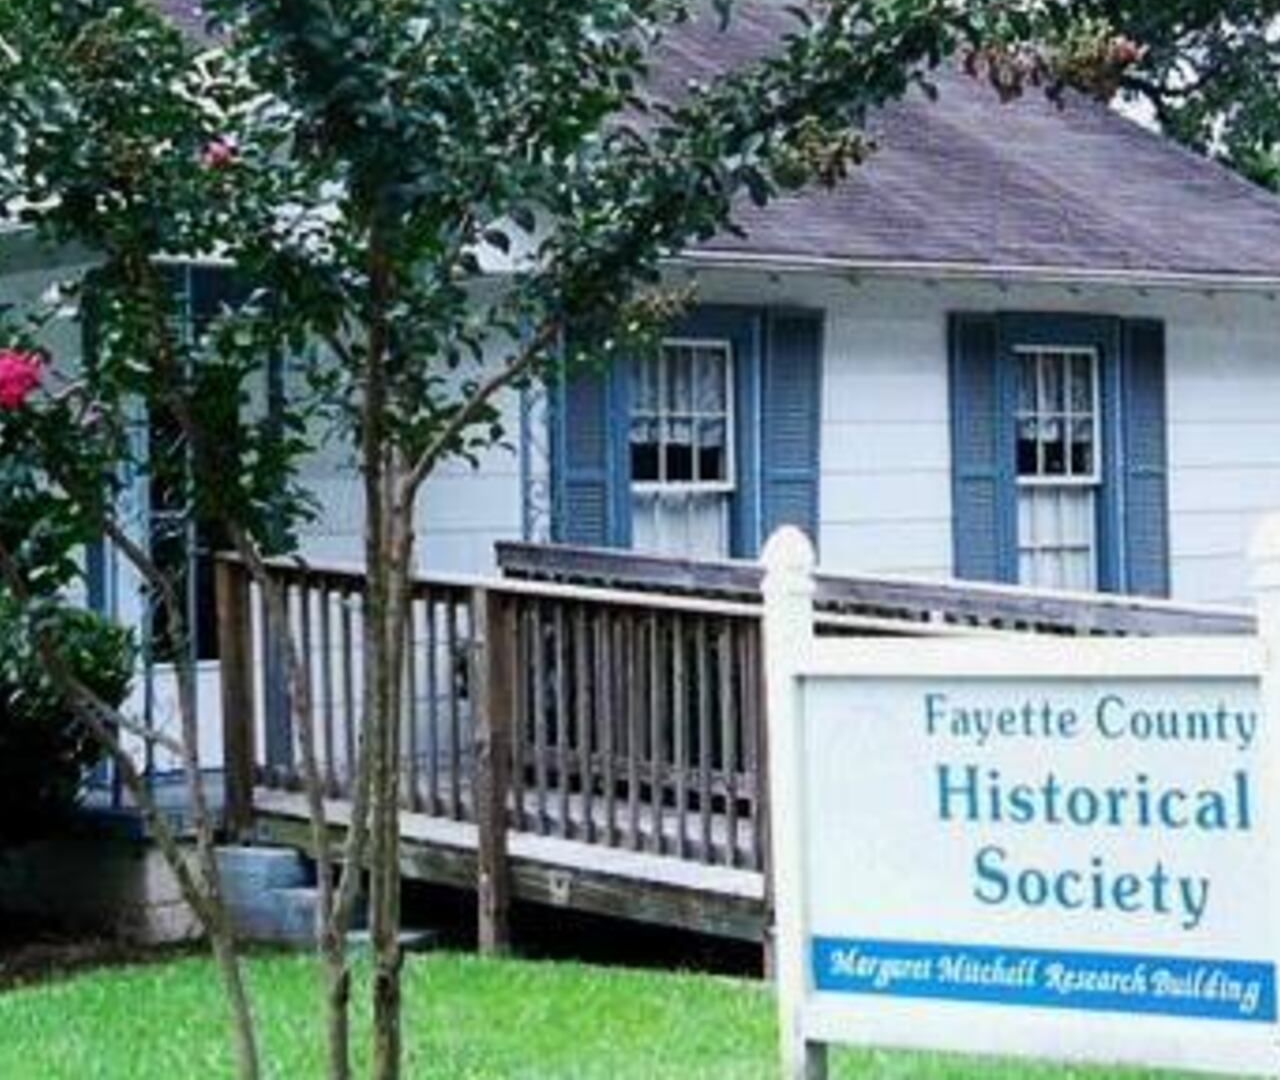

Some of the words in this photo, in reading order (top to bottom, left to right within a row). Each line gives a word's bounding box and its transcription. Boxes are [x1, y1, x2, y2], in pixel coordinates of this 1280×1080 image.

[924, 693, 1077, 746] Fayette
[1095, 694, 1258, 750] County
[937, 764, 1252, 830] Historical
[972, 845, 1210, 930] Society
[830, 947, 931, 988] Margaret
[937, 954, 1038, 986] Mitchell
[1045, 962, 1148, 995] Research
[1151, 967, 1261, 1012] Building
